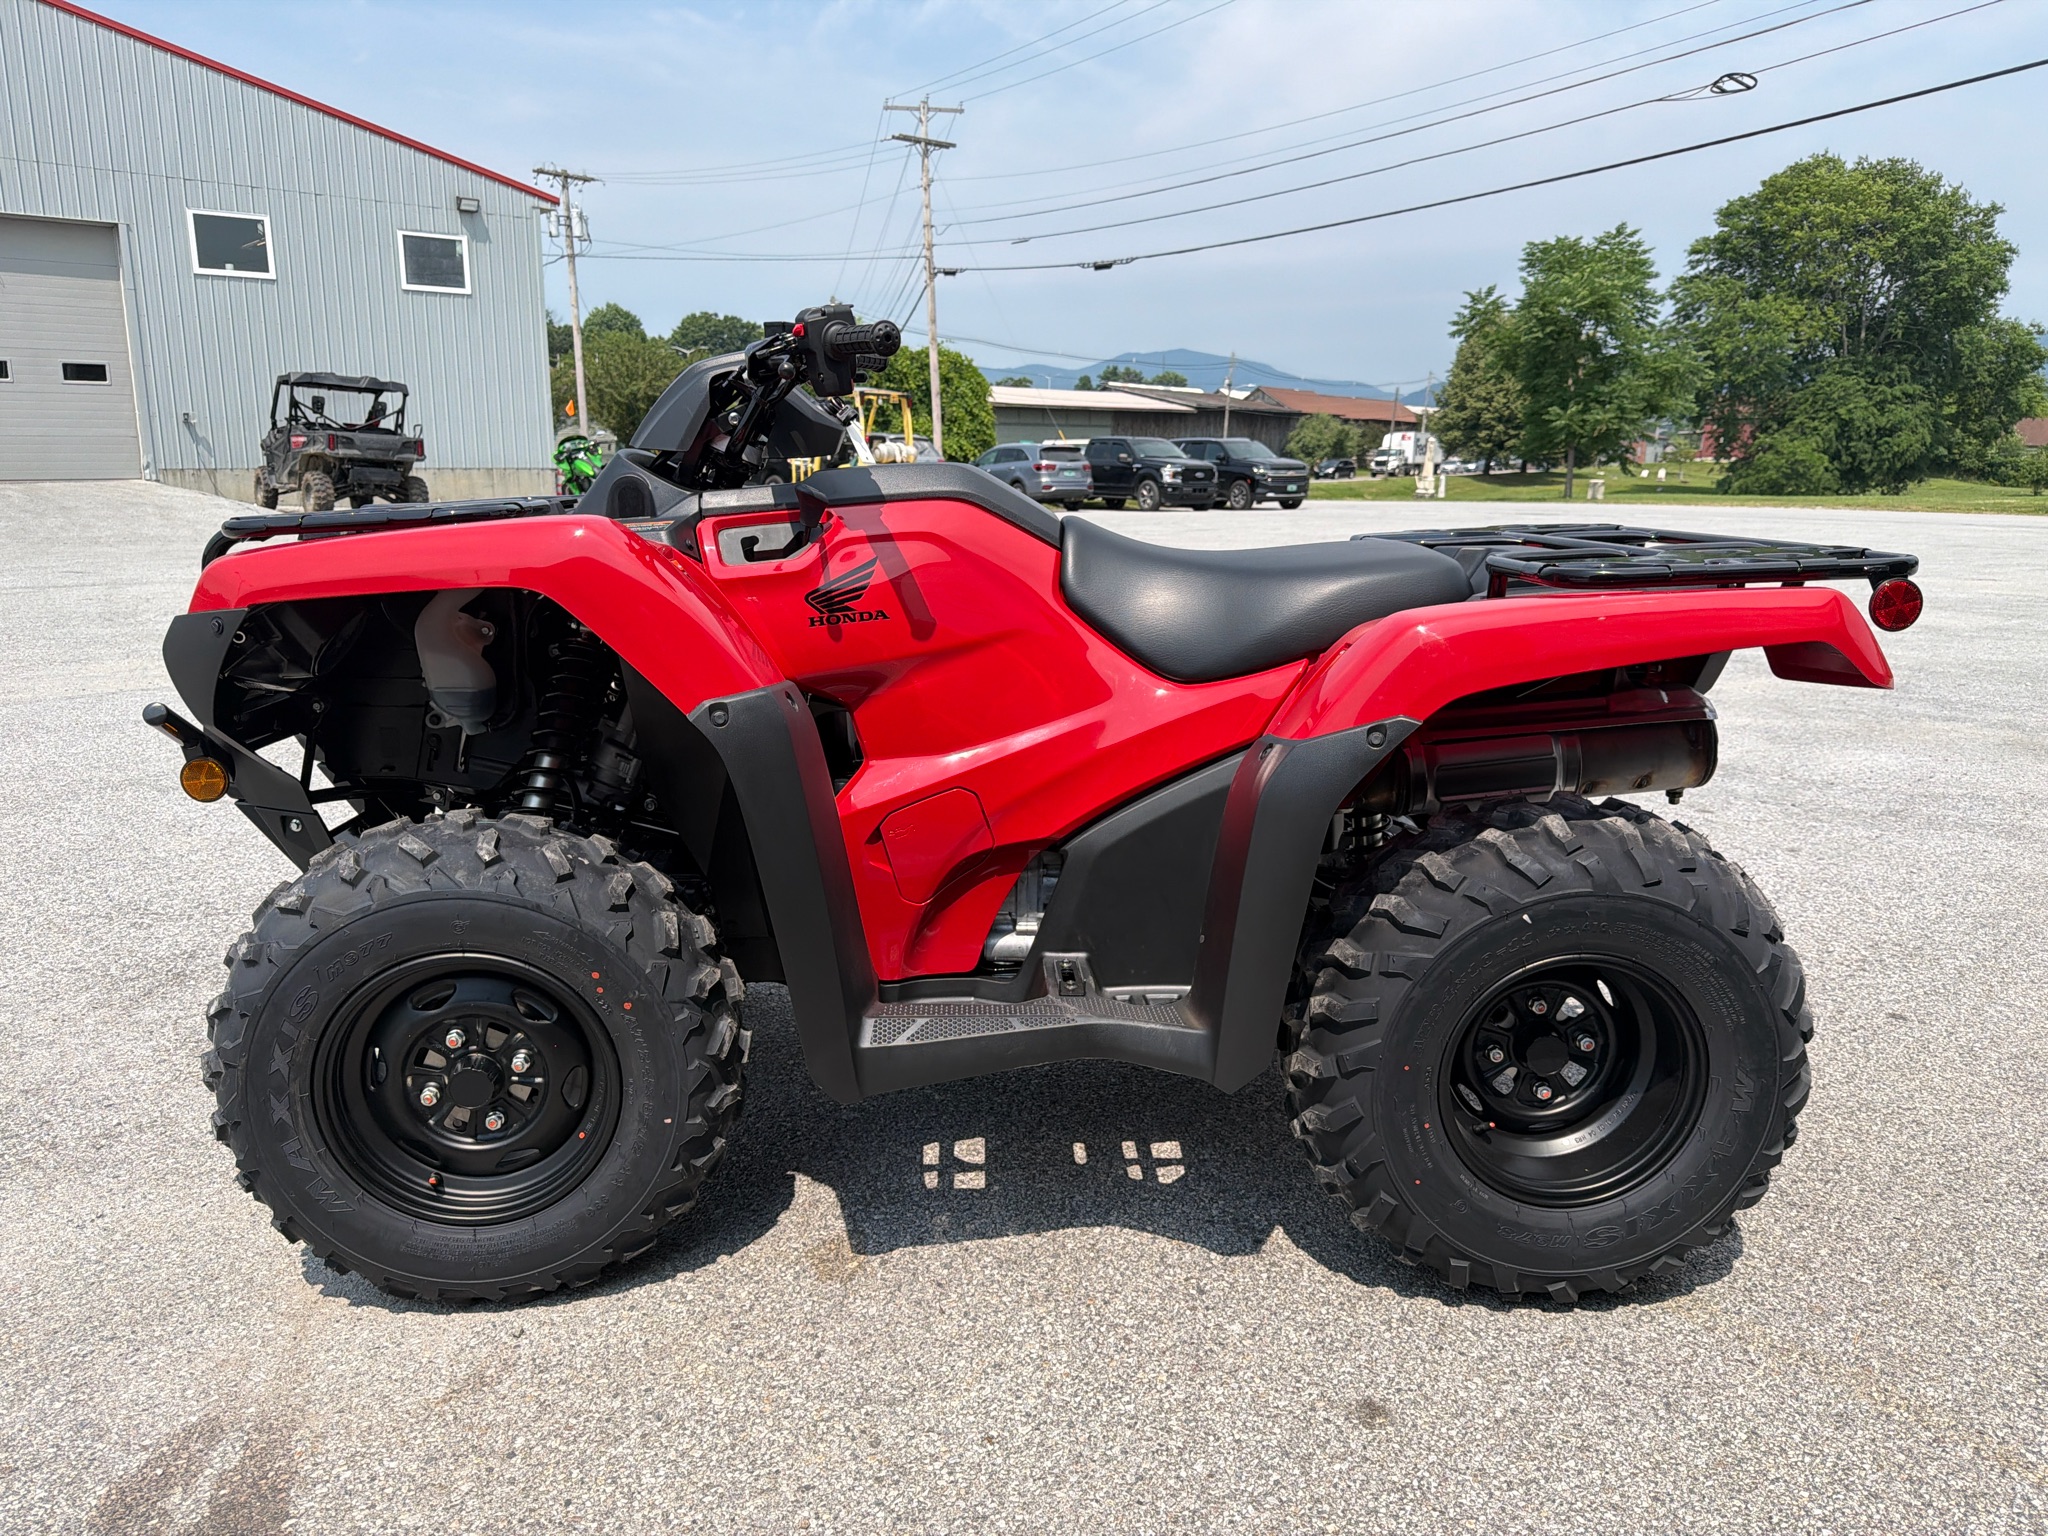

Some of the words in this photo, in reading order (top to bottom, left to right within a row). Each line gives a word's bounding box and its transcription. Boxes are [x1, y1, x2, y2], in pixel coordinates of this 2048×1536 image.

[809, 611, 890, 627] HONDA
[326, 931, 393, 982] M977
[268, 984, 357, 1212] MAXXIS
[1583, 1065, 1755, 1249] MAXXIS
